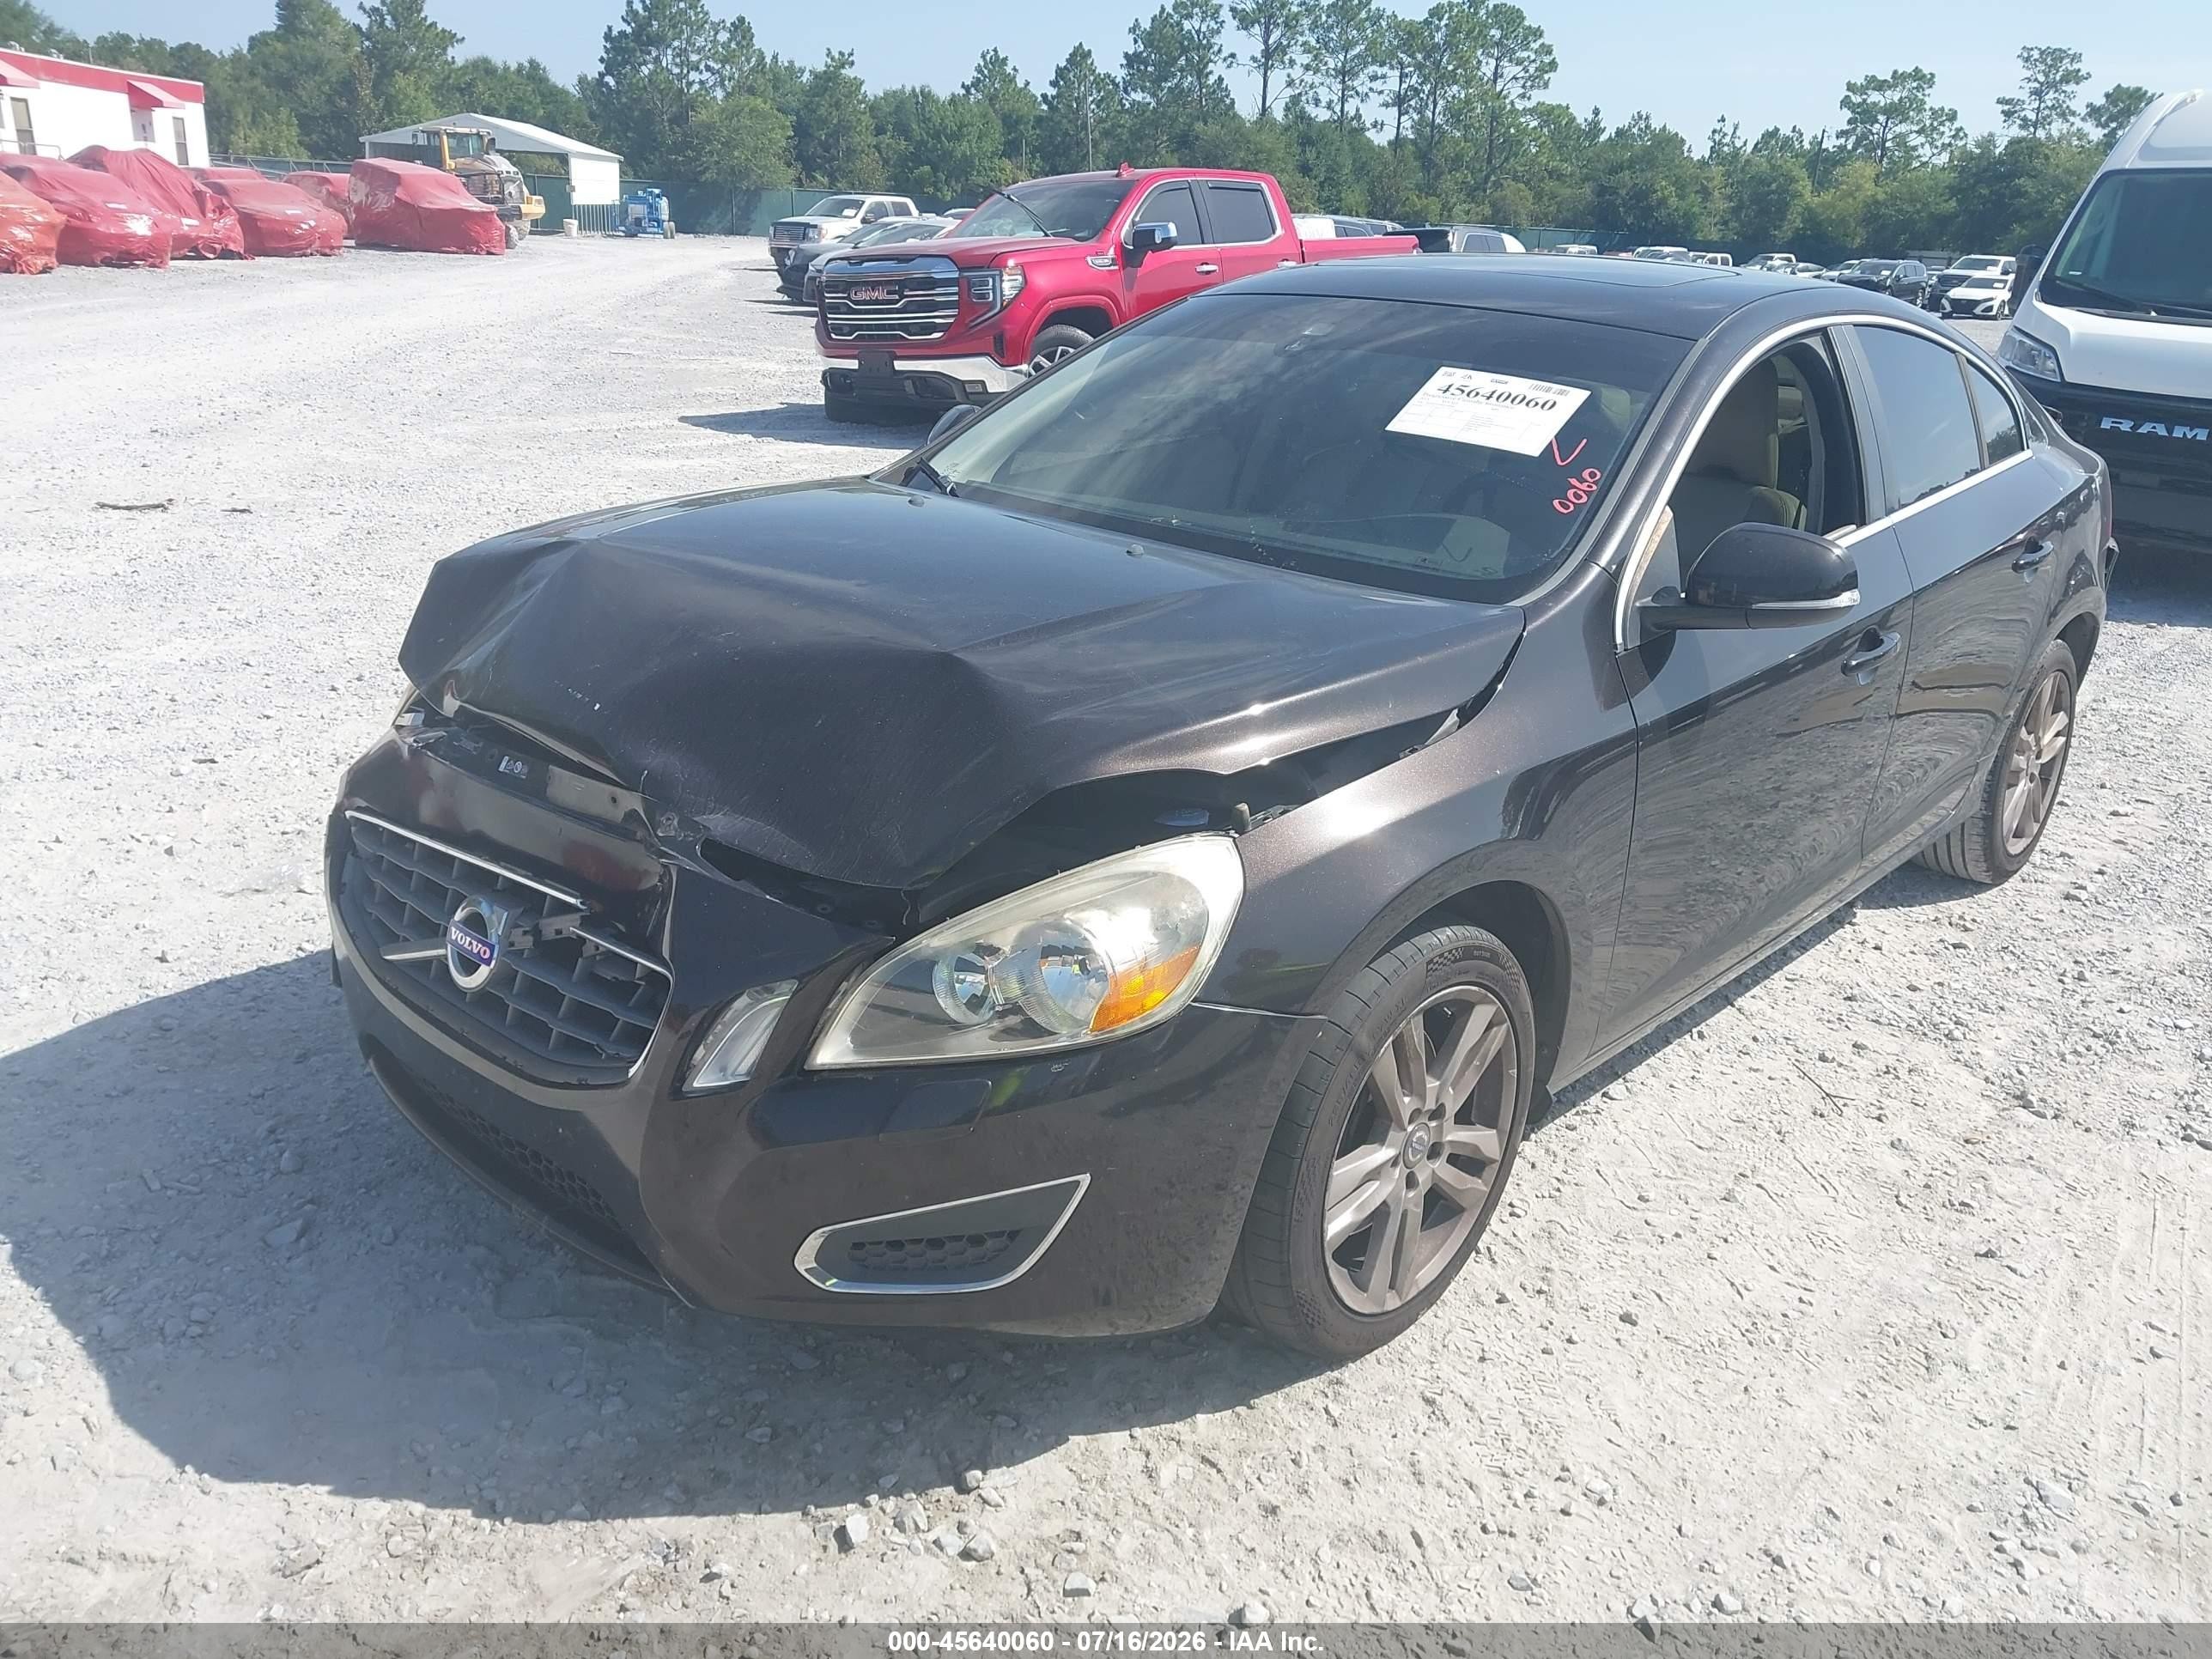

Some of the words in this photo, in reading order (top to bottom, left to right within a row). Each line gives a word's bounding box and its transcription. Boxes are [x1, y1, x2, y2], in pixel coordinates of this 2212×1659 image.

[850, 285, 900, 301] GMC
[1437, 383, 1558, 412] 45640060
[2100, 416, 2210, 441] RAM
[450, 927, 491, 960] VOLVO
